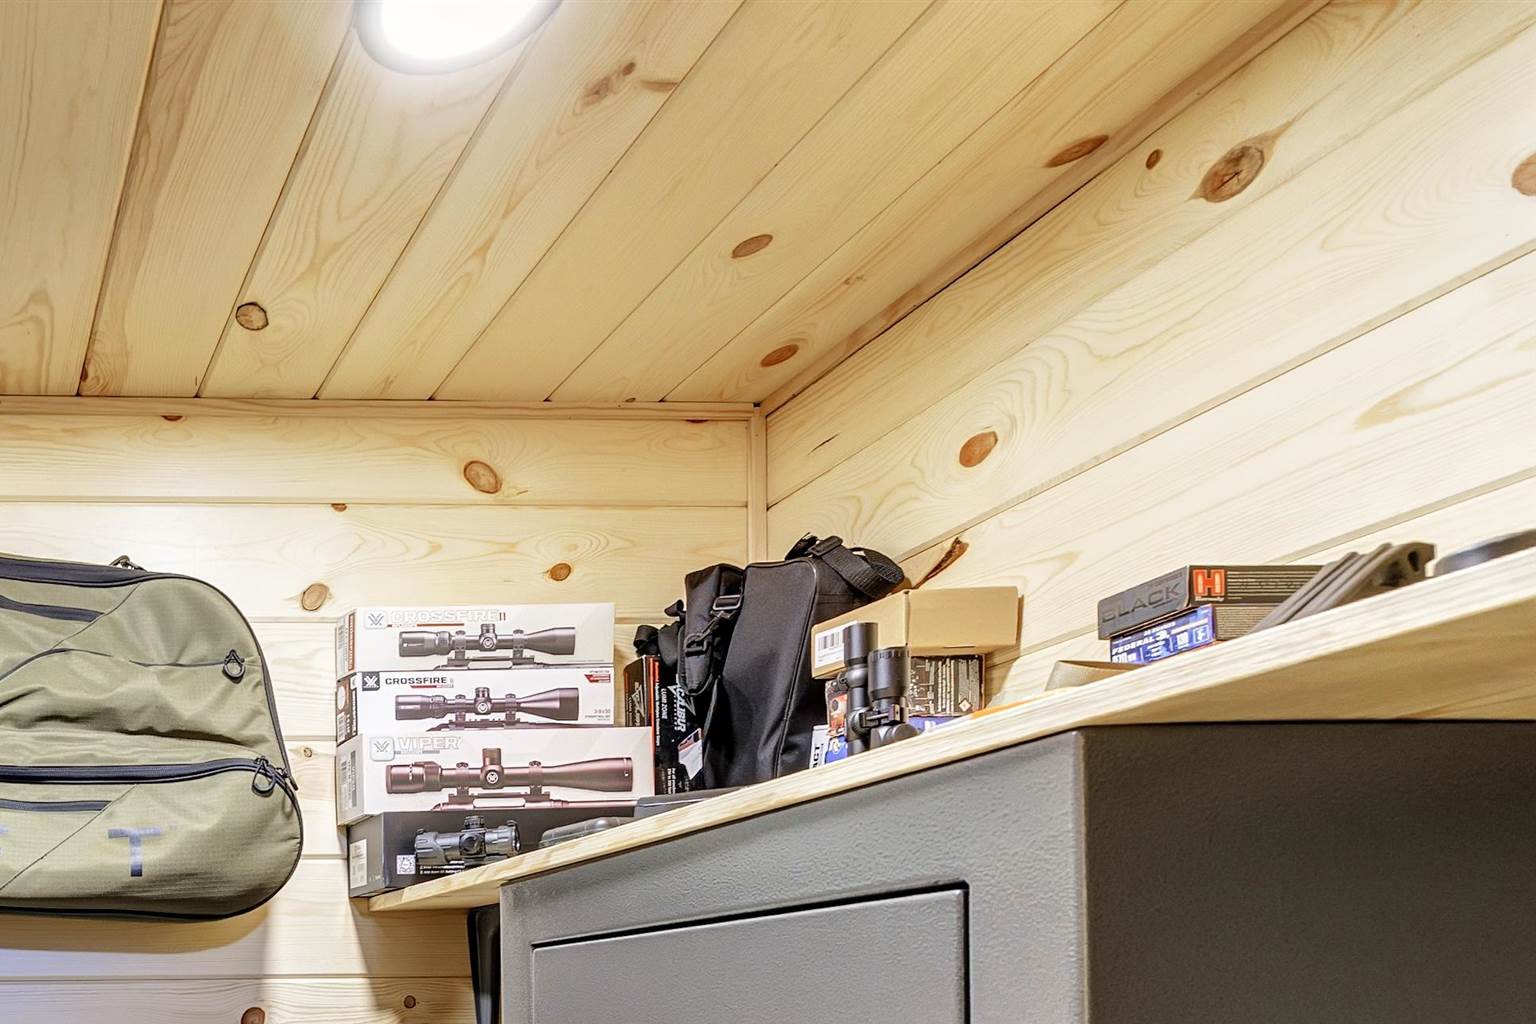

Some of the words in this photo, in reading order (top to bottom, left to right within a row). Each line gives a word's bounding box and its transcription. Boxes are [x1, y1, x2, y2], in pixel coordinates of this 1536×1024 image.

[1192, 569, 1225, 596] H
[1101, 582, 1181, 623] BLACK
[390, 611, 499, 623] CROSSFIRE
[1111, 635, 1156, 656] FEDERAL
[385, 677, 448, 685] CROSSFIRE
[398, 737, 459, 750] VIPER
